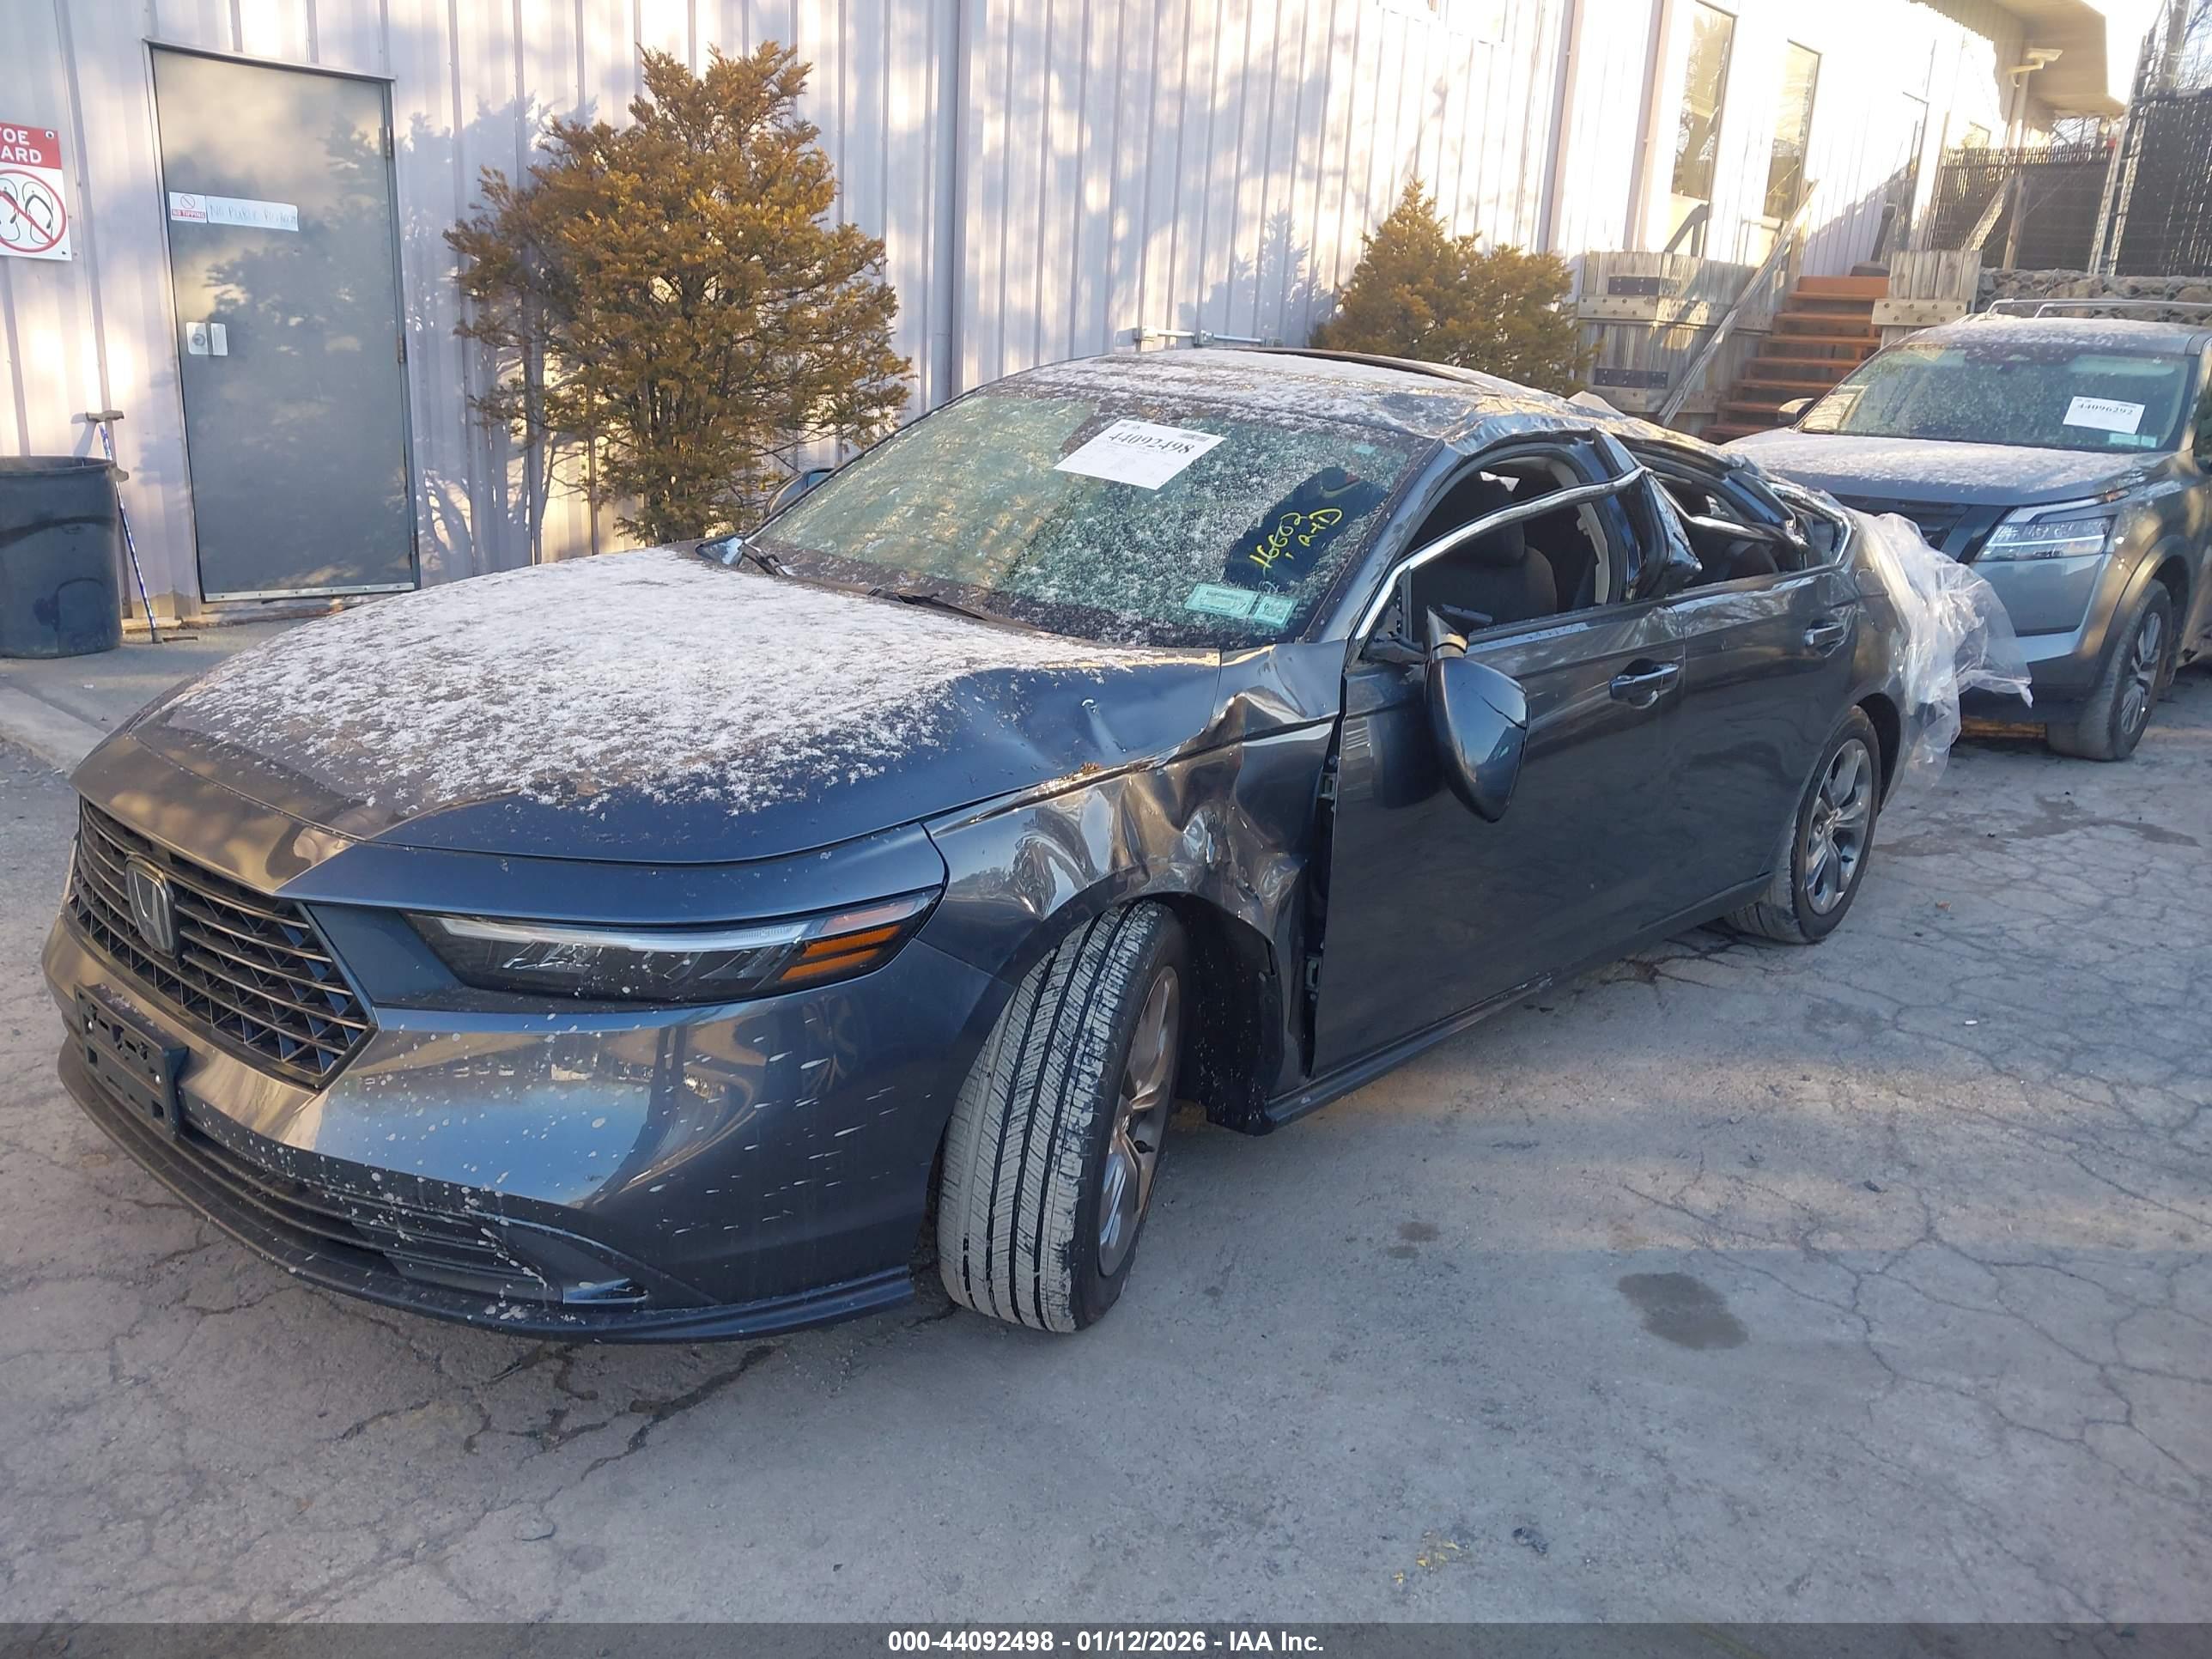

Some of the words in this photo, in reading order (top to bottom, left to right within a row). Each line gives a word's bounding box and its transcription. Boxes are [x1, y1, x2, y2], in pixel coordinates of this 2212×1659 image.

[0, 127, 30, 145] OE
[0, 144, 42, 164] ARD
[1109, 431, 1195, 454] 44092498
